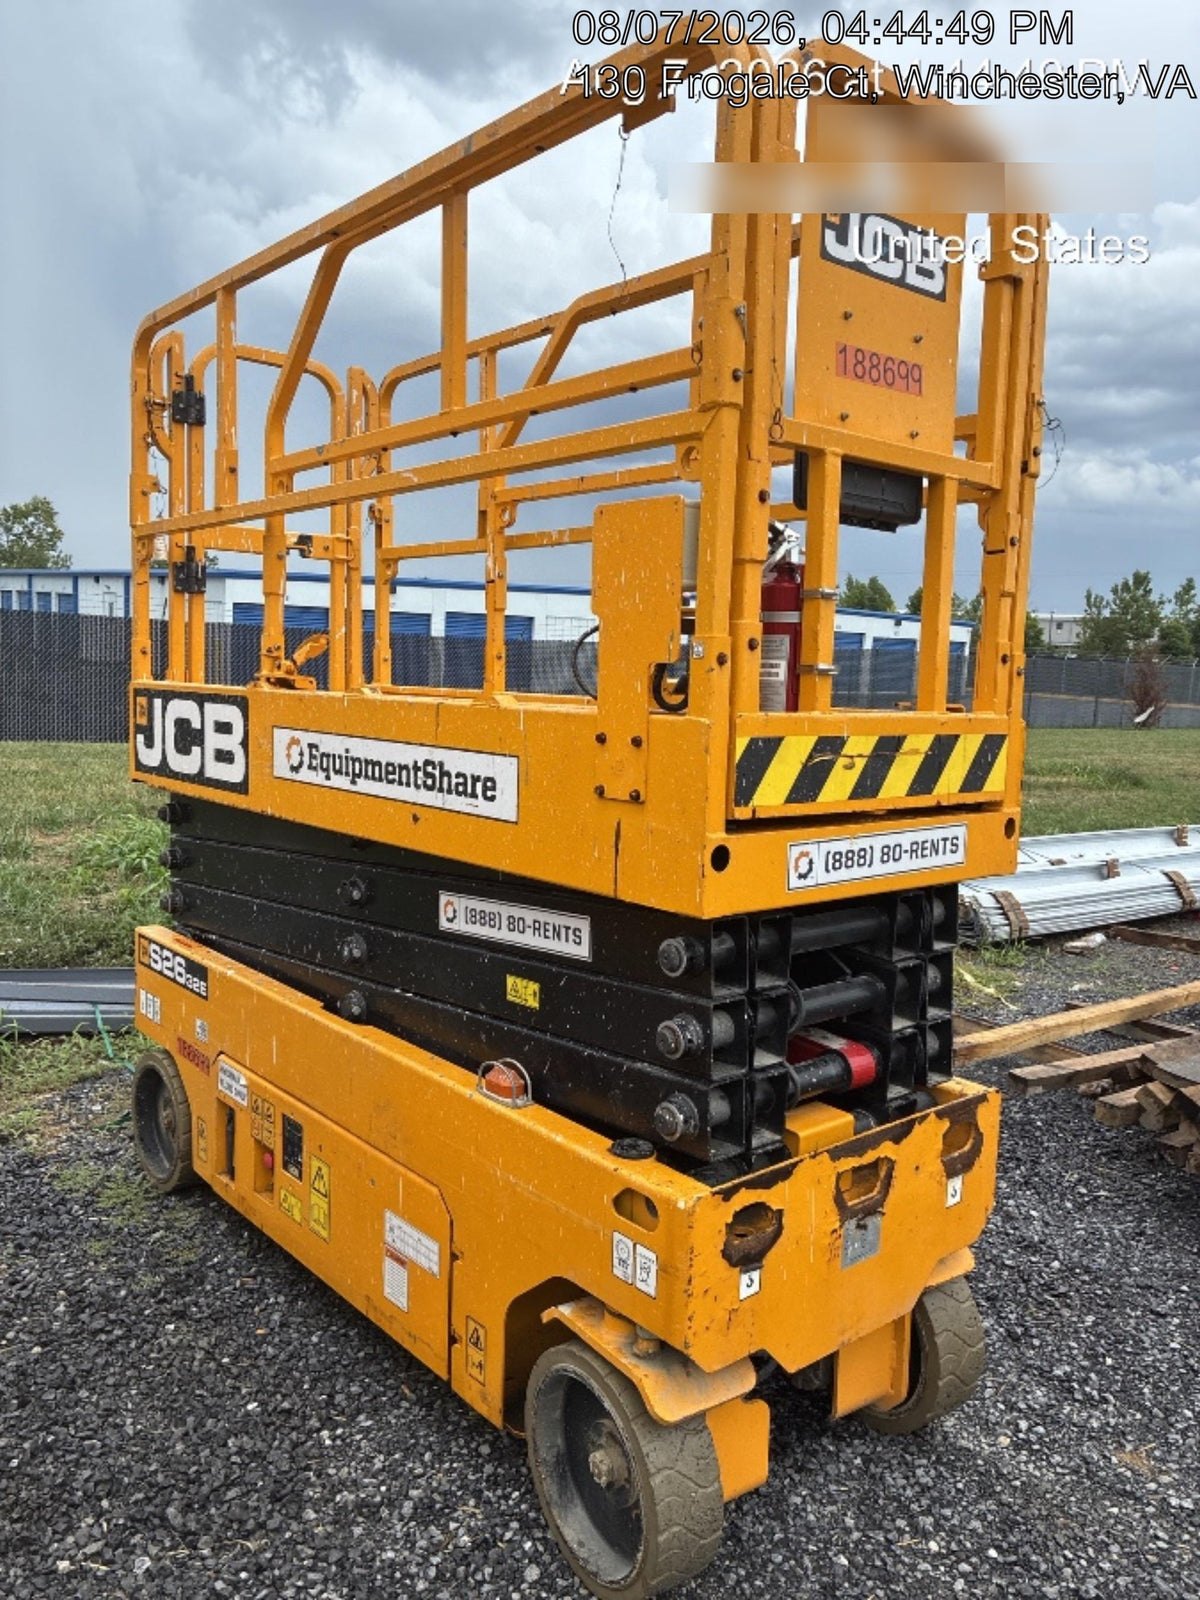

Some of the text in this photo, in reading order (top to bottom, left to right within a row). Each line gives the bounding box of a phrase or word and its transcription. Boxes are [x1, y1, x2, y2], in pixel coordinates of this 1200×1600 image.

[824, 213, 945, 295] JCB
[839, 344, 922, 397] 188699
[136, 697, 245, 784] JCB
[307, 742, 497, 802] EquipmentShare
[825, 835, 960, 873] (888) 80-RENTS
[464, 905, 583, 946] (888) 80-RENTS
